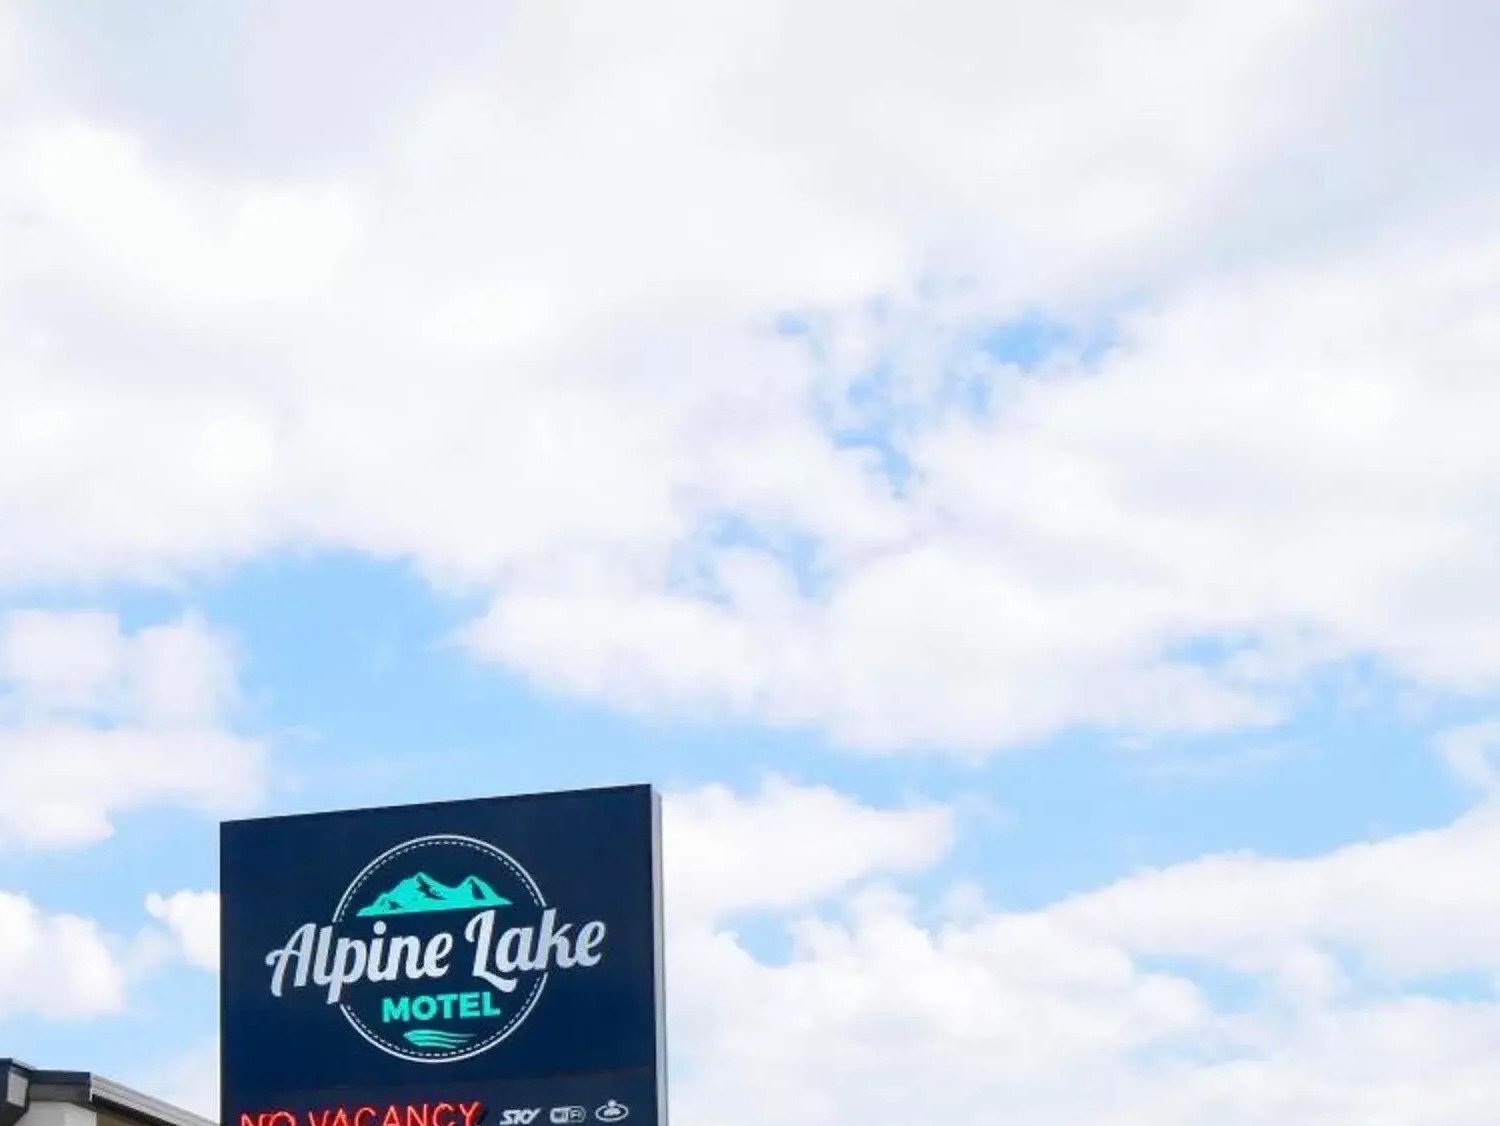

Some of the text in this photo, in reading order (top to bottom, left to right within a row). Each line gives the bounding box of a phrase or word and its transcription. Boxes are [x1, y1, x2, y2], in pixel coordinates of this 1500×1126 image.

[265, 906, 606, 1005] Alpine Lake
[382, 990, 502, 1023] MOTEL
